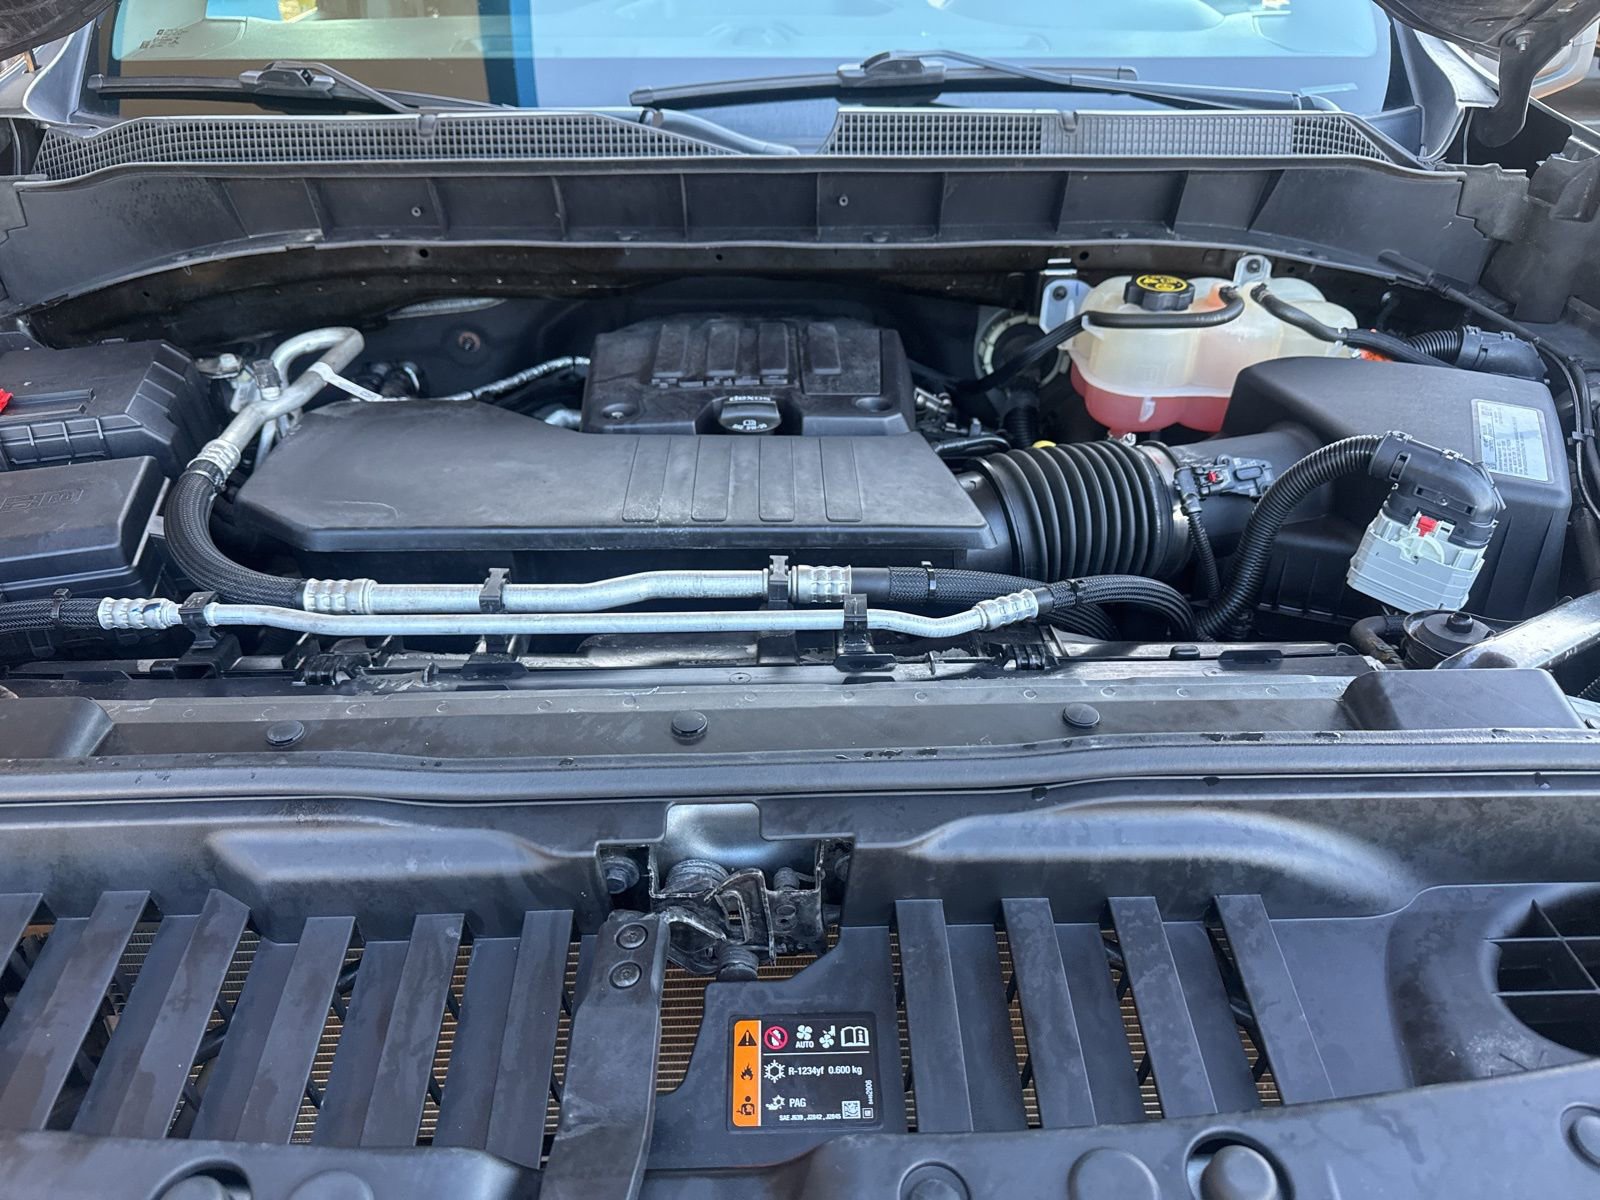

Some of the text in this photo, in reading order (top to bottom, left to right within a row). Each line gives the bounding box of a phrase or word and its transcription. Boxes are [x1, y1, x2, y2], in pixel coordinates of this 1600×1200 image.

[795, 1040, 815, 1049] AUTO
[788, 1065, 863, 1077] R-1234yf 0.600 kg
[789, 1098, 807, 1108] PAG
